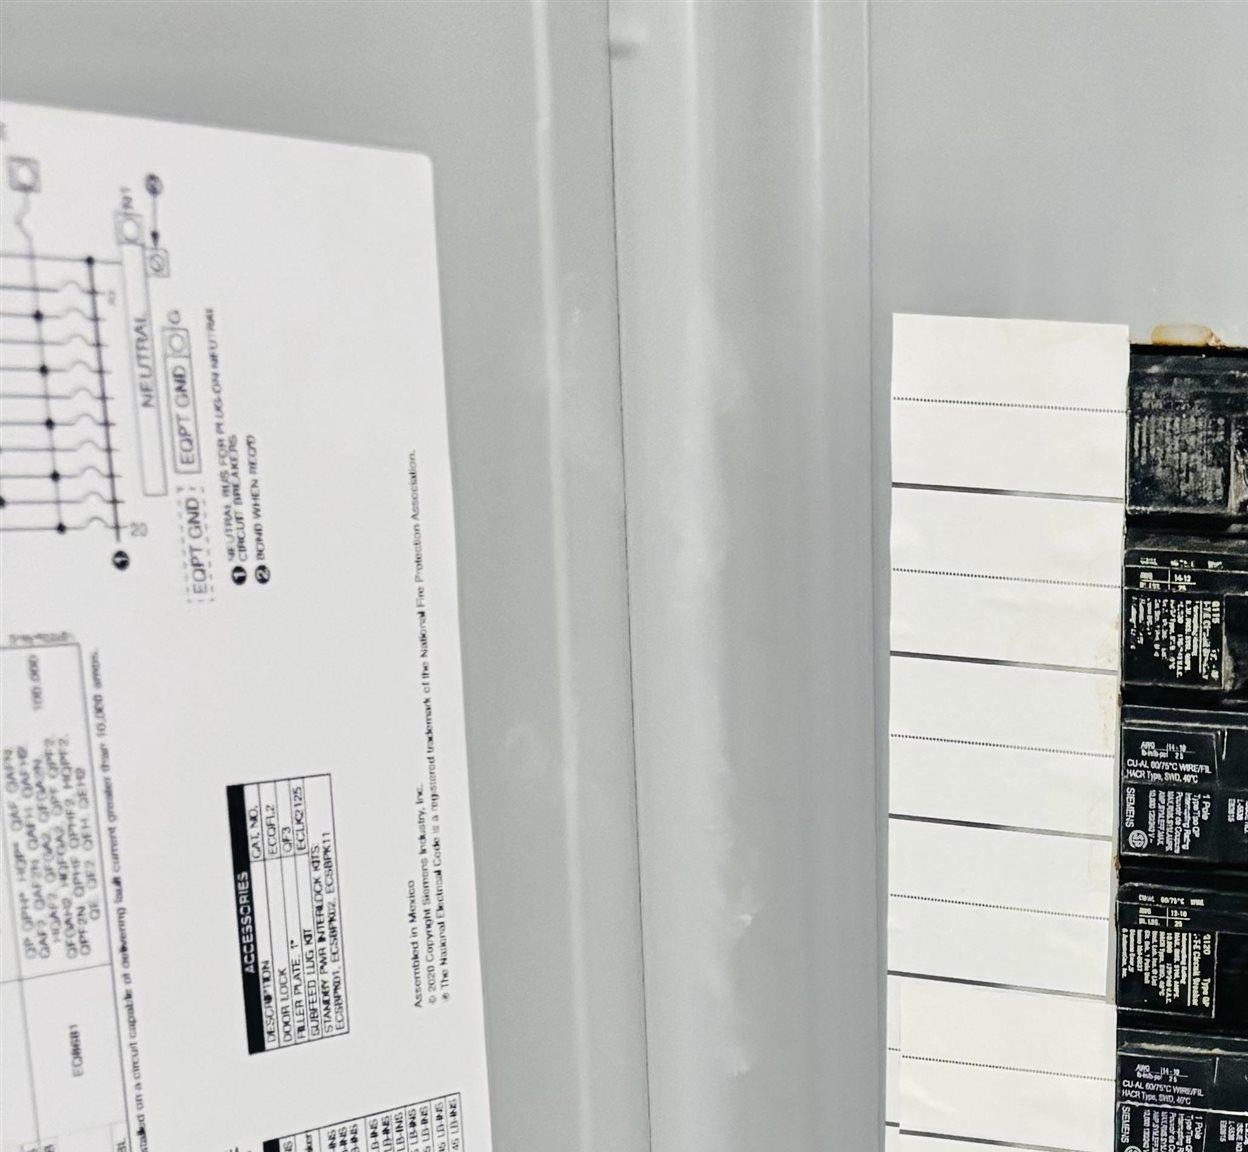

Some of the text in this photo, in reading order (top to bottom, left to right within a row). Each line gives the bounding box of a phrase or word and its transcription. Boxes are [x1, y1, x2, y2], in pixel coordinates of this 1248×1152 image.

[134, 317, 154, 407] NEUTRAL
[171, 365, 194, 464] EQPT GND
[185, 497, 207, 593] EQPT GND
[1125, 787, 1135, 828] SIEMENS
[237, 871, 254, 973] ACCESSORIES
[408, 880, 416, 922] Mexico
[277, 967, 292, 1042] DOOR LOCK
[303, 928, 320, 1036] SUBFEED LUG KIT
[410, 940, 422, 1007] Assembled
[294, 999, 305, 1038] FILLER
[1120, 1105, 1130, 1143] SIEMENS
